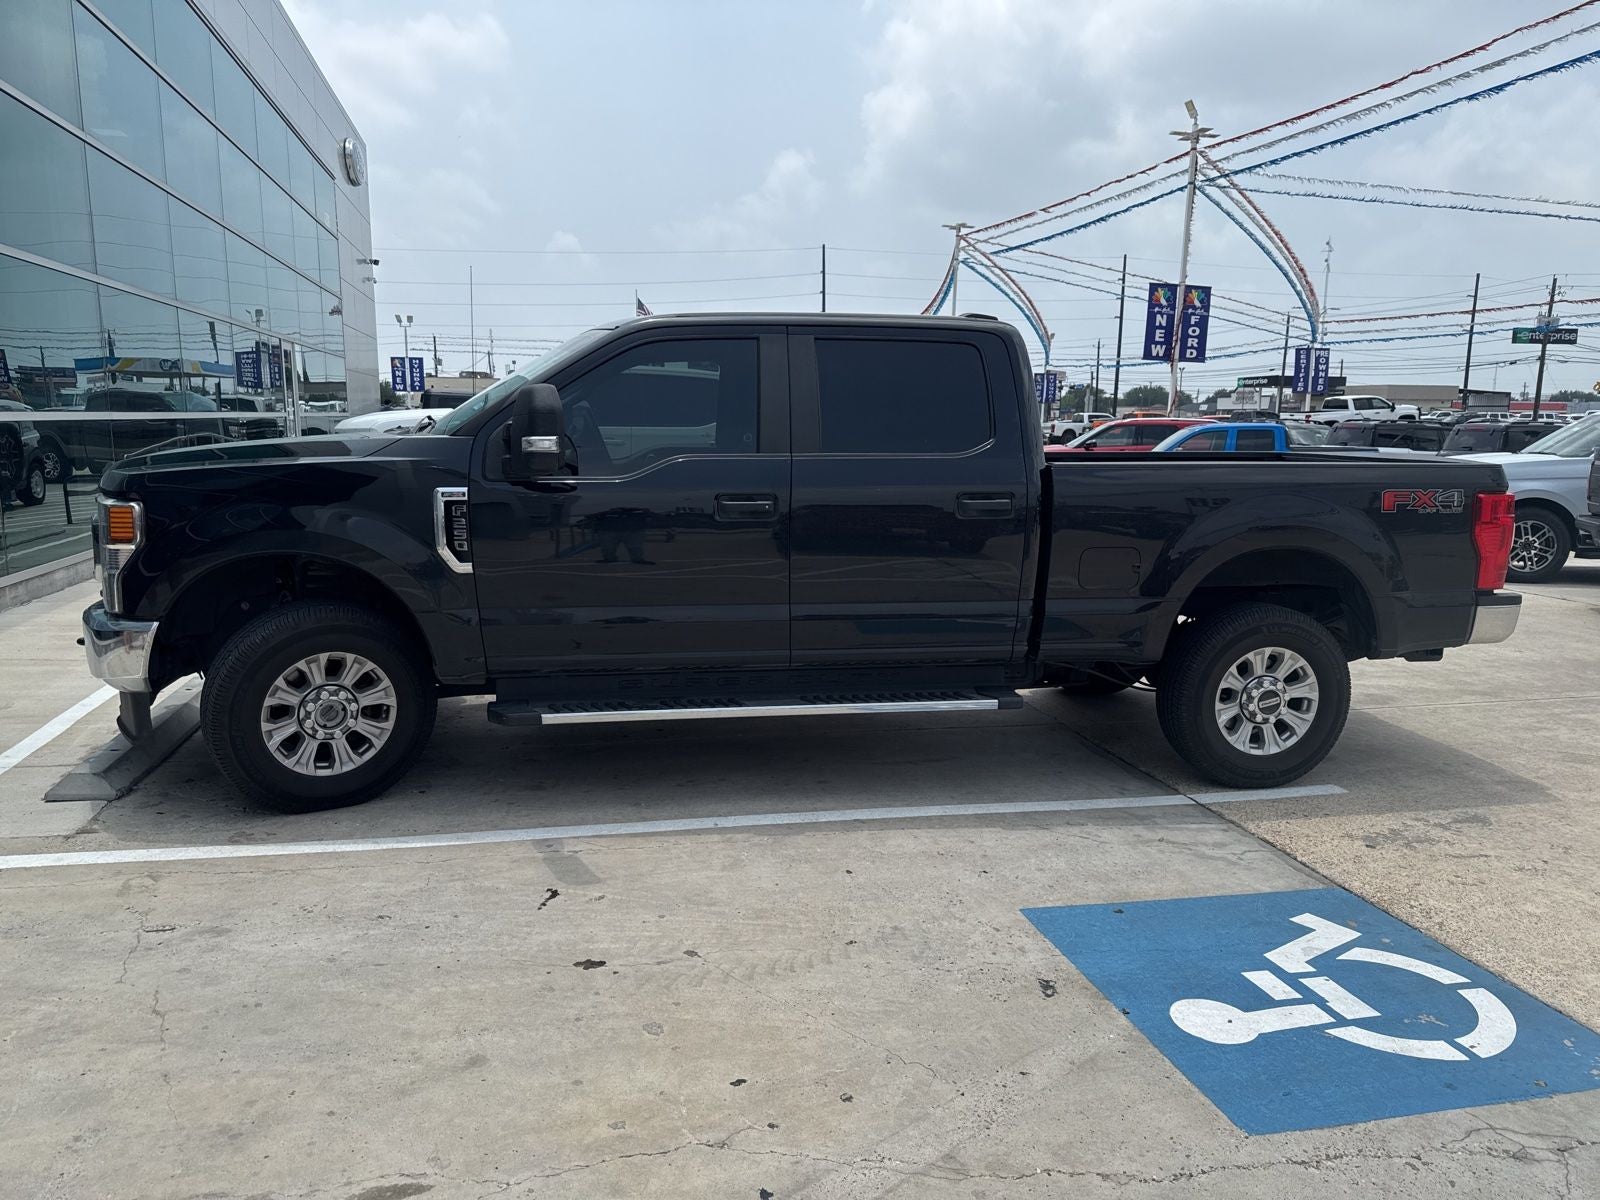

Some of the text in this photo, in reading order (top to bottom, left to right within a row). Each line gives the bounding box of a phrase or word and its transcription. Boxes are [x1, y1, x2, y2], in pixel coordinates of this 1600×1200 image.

[1151, 314, 1167, 357] NEW
[1185, 315, 1200, 358] FORD
[1517, 329, 1577, 341] enteprise
[395, 370, 404, 390] NEW
[412, 359, 420, 390] HYUNDAI
[1297, 350, 1306, 392] CERTIFIED
[1317, 357, 1327, 391] OWNED
[1381, 489, 1464, 512] FX4
